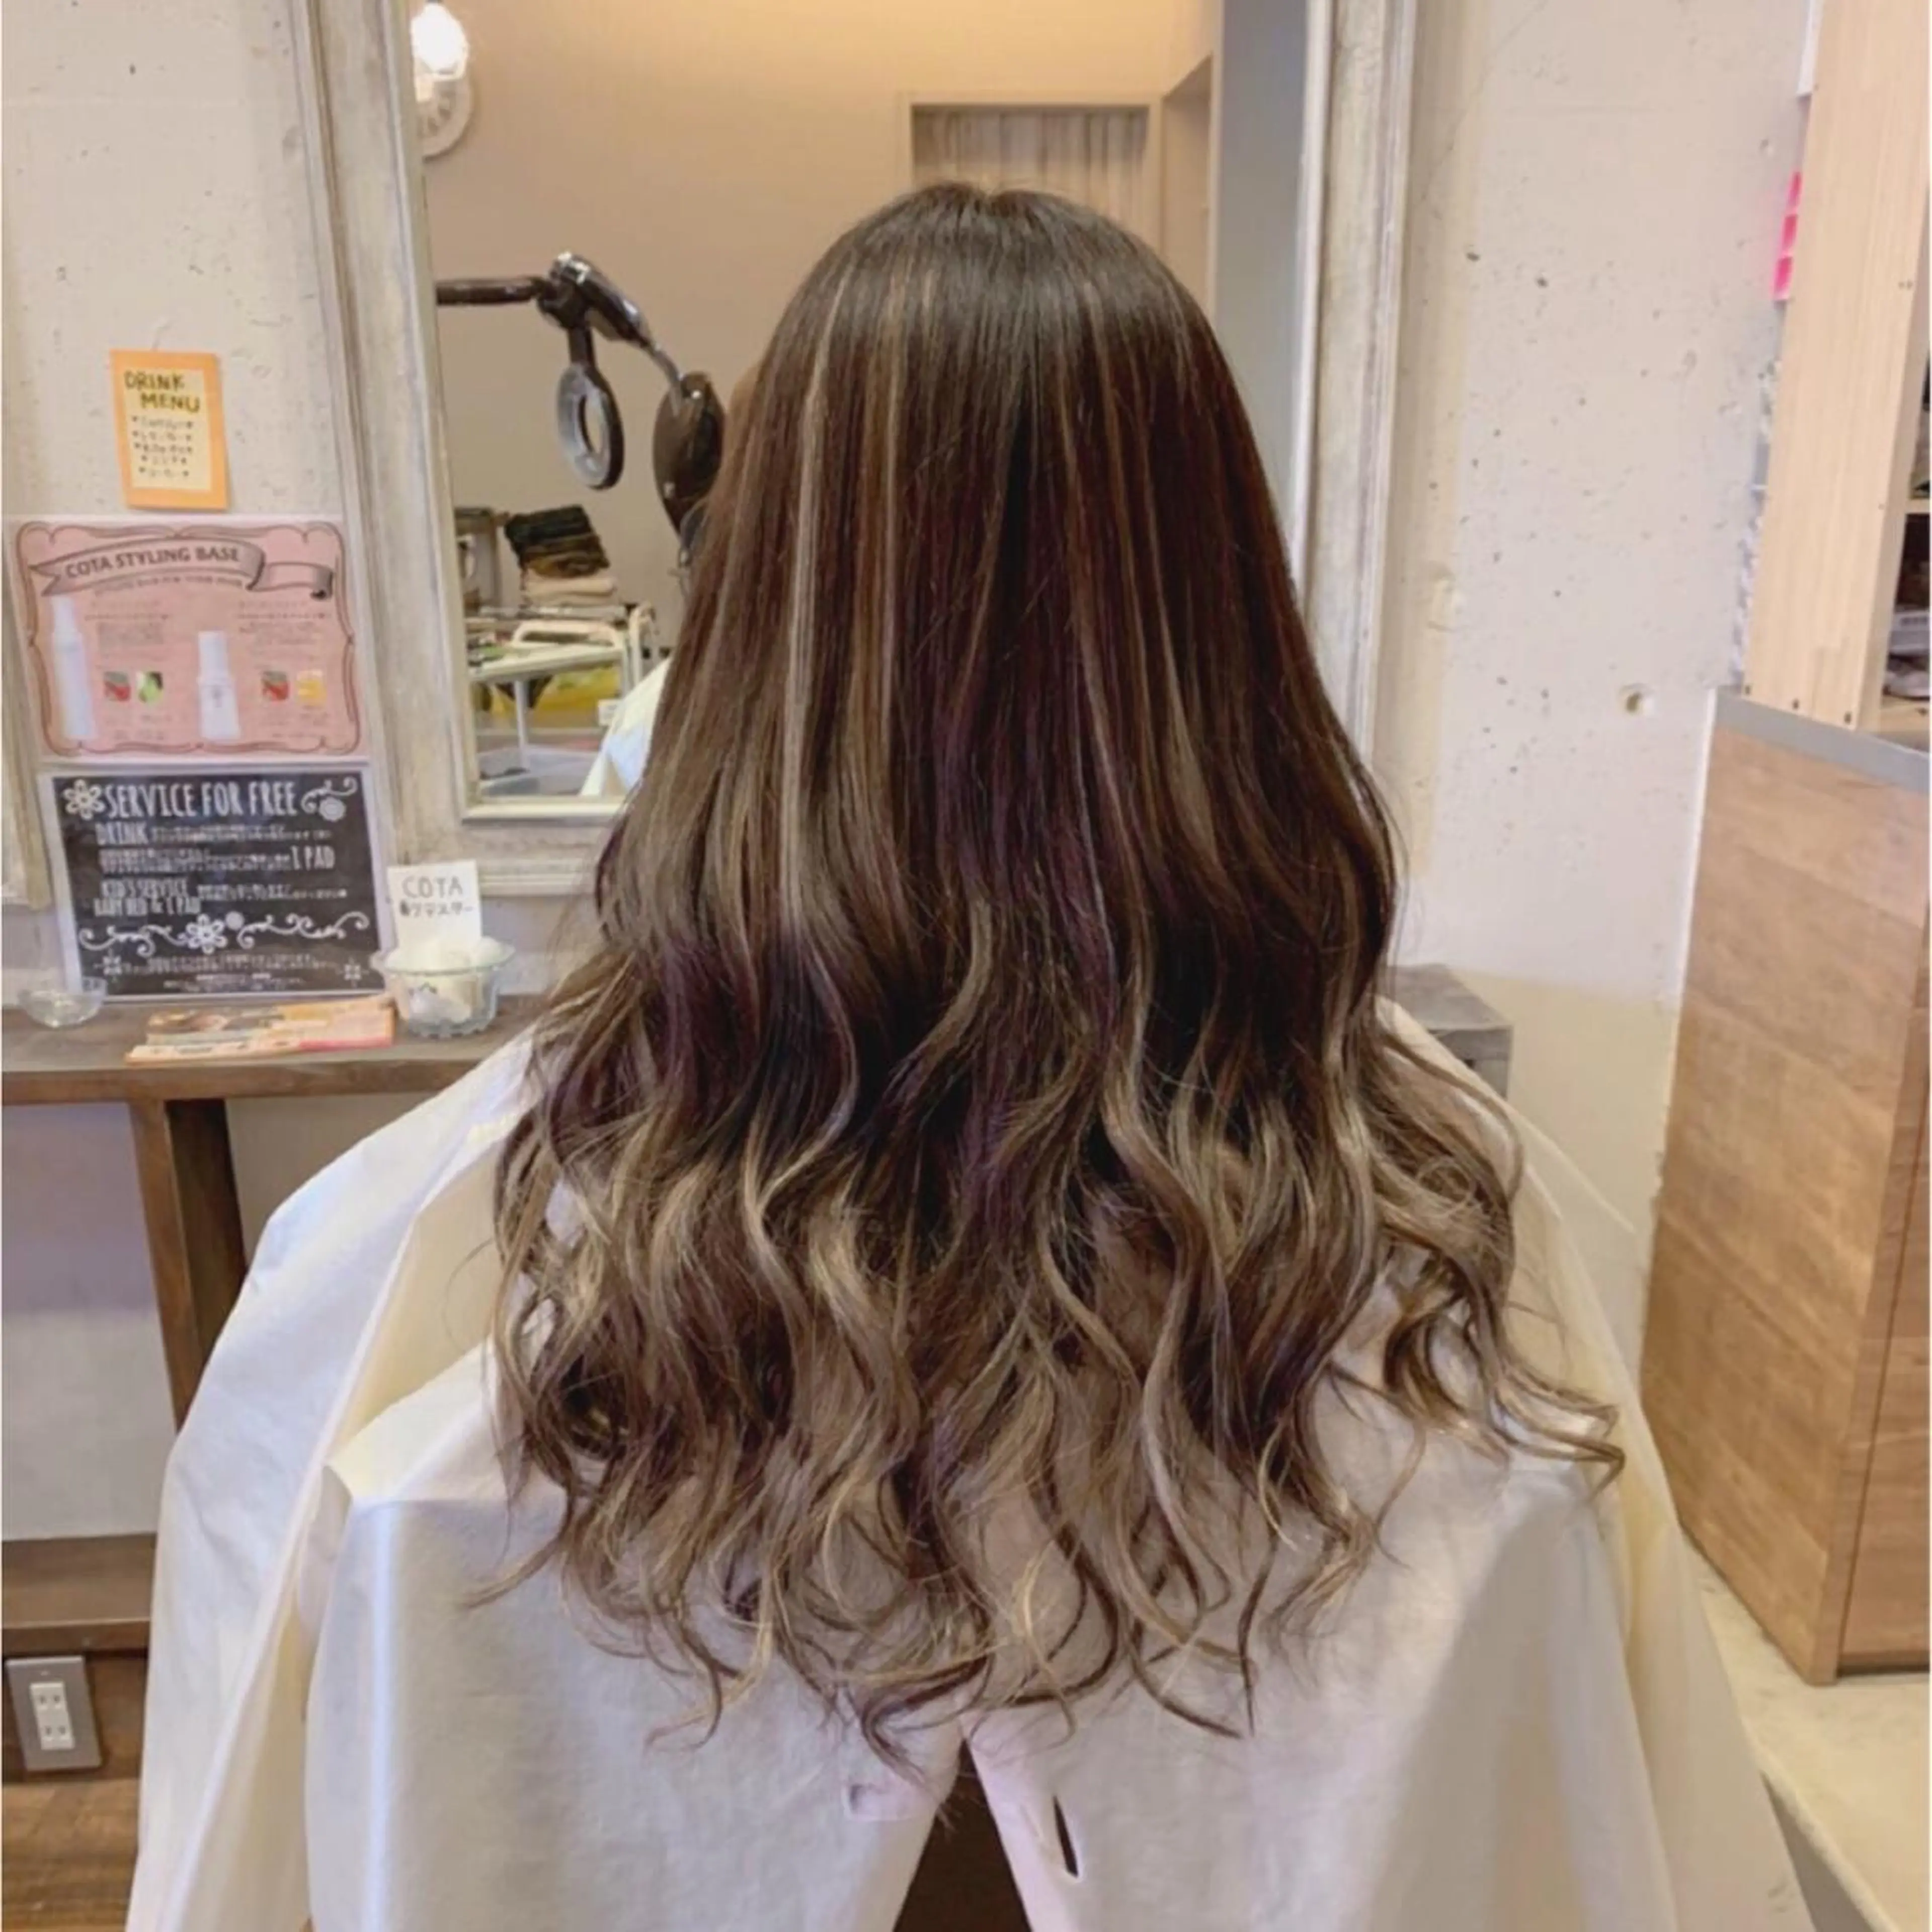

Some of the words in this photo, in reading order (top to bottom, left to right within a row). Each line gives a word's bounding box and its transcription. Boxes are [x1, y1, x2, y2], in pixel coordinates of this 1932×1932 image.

[124, 371, 185, 391] DRINK
[140, 392, 199, 413] MENU
[65, 556, 113, 578] COTA
[115, 547, 191, 569] STYLING
[195, 546, 239, 561] BASE
[105, 783, 197, 819] SERVICE
[201, 781, 244, 817] FOR
[248, 781, 298, 816] FREE
[402, 875, 463, 898] COTA
